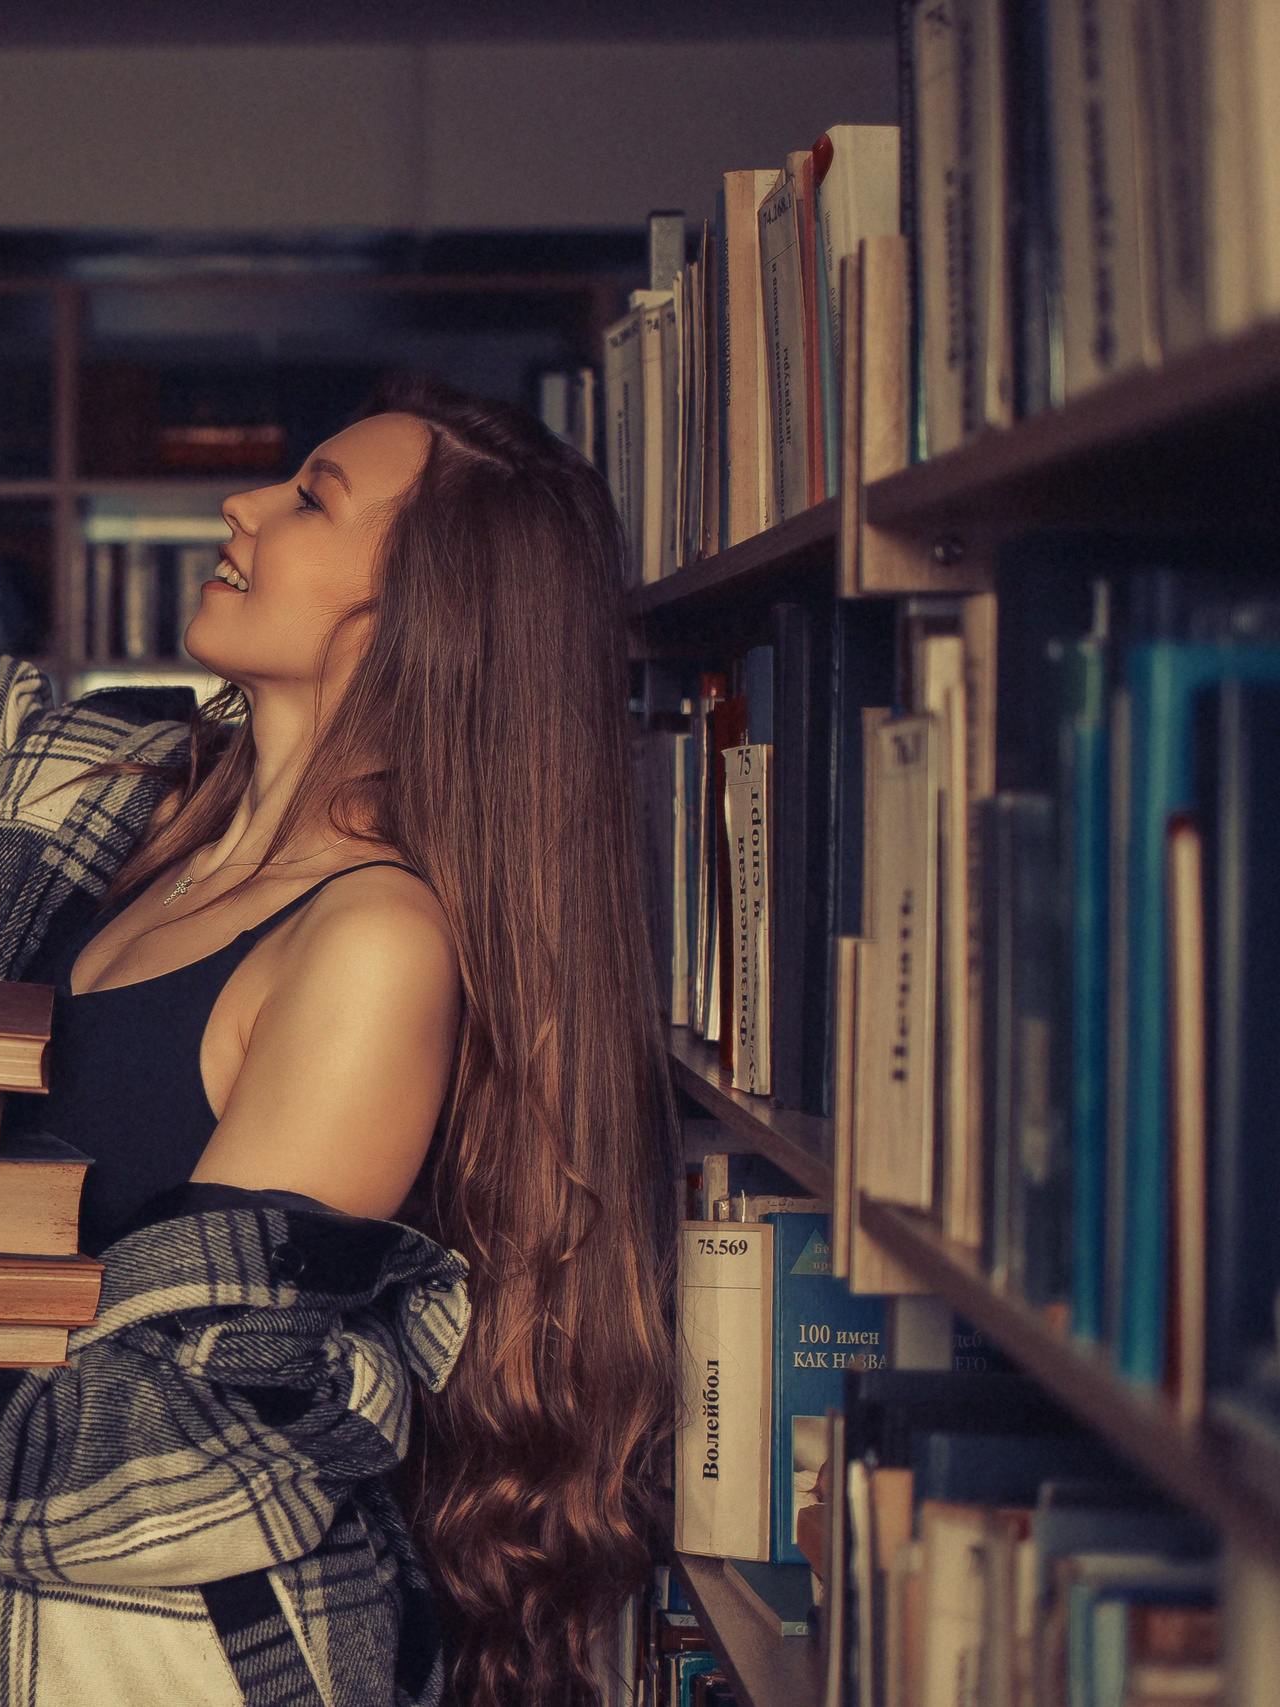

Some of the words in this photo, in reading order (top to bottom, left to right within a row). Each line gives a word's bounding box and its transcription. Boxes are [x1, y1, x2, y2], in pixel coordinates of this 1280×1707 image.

[771, 262, 777, 273] и
[772, 277, 780, 337] языков
[783, 347, 791, 445] литературы
[737, 748, 751, 776] 75
[750, 787, 761, 887] спорт
[753, 900, 760, 918] и
[738, 836, 747, 1046] Физическая
[698, 1239, 748, 1255] 75.569
[798, 1324, 831, 1344] 100
[836, 1330, 880, 1345] имен
[793, 1351, 829, 1368] КАК
[702, 1359, 719, 1482] Волейбол
